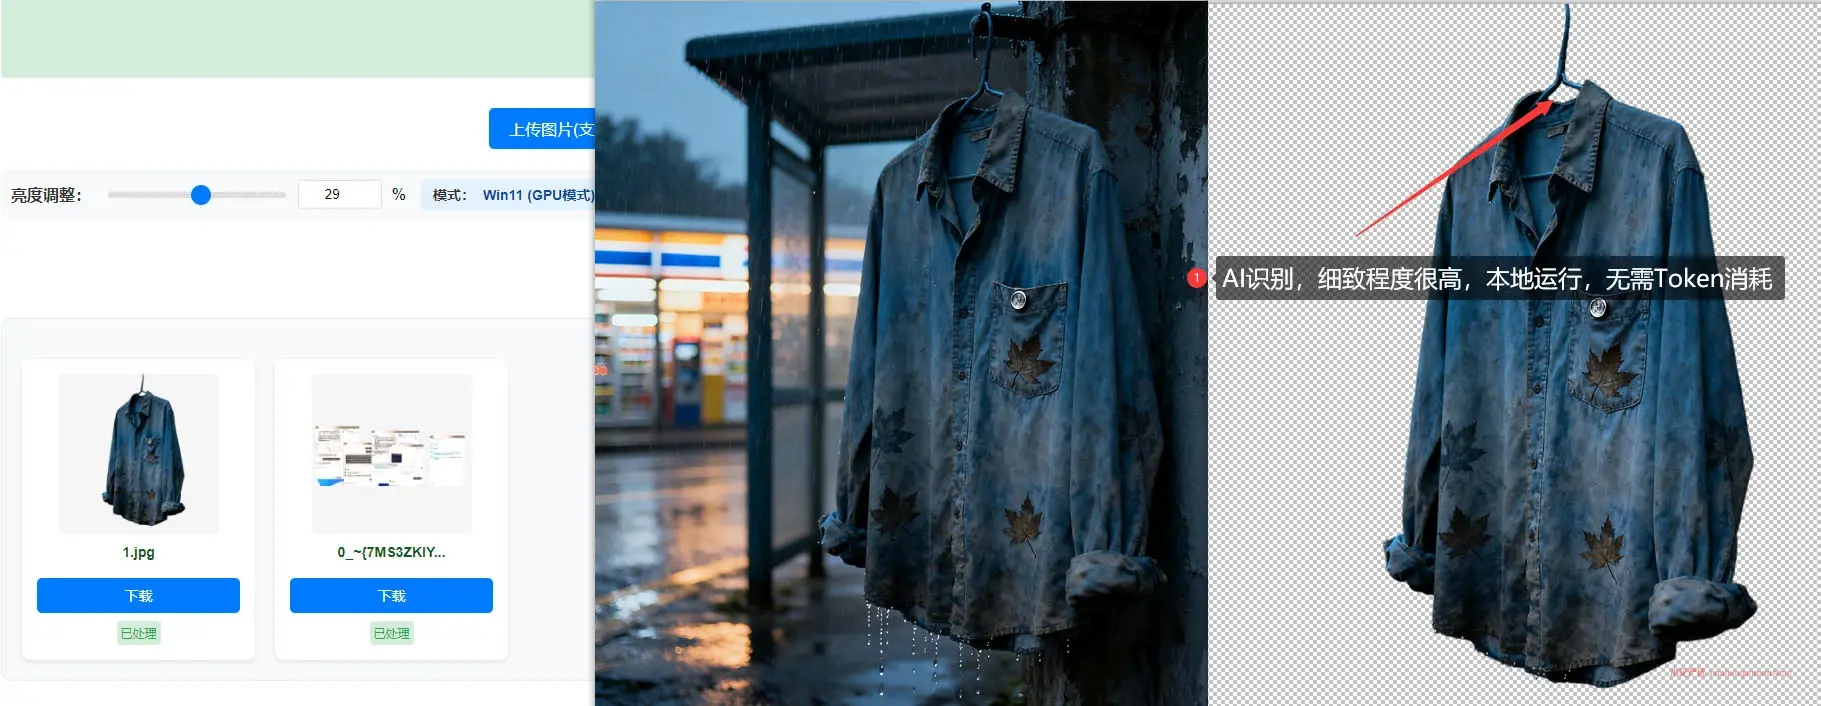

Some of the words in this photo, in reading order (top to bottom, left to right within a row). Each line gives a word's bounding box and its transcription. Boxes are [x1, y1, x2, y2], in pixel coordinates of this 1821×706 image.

[324, 189, 340, 200] 29
[392, 188, 406, 201] %
[483, 189, 522, 201] Win11
[527, 189, 594, 203] (GPU模式)
[122, 546, 155, 561] 1.jpg
[125, 589, 154, 604] 下载
[378, 589, 407, 603] 下载
[120, 626, 157, 640] 已处理
[373, 626, 410, 640] 已处理
